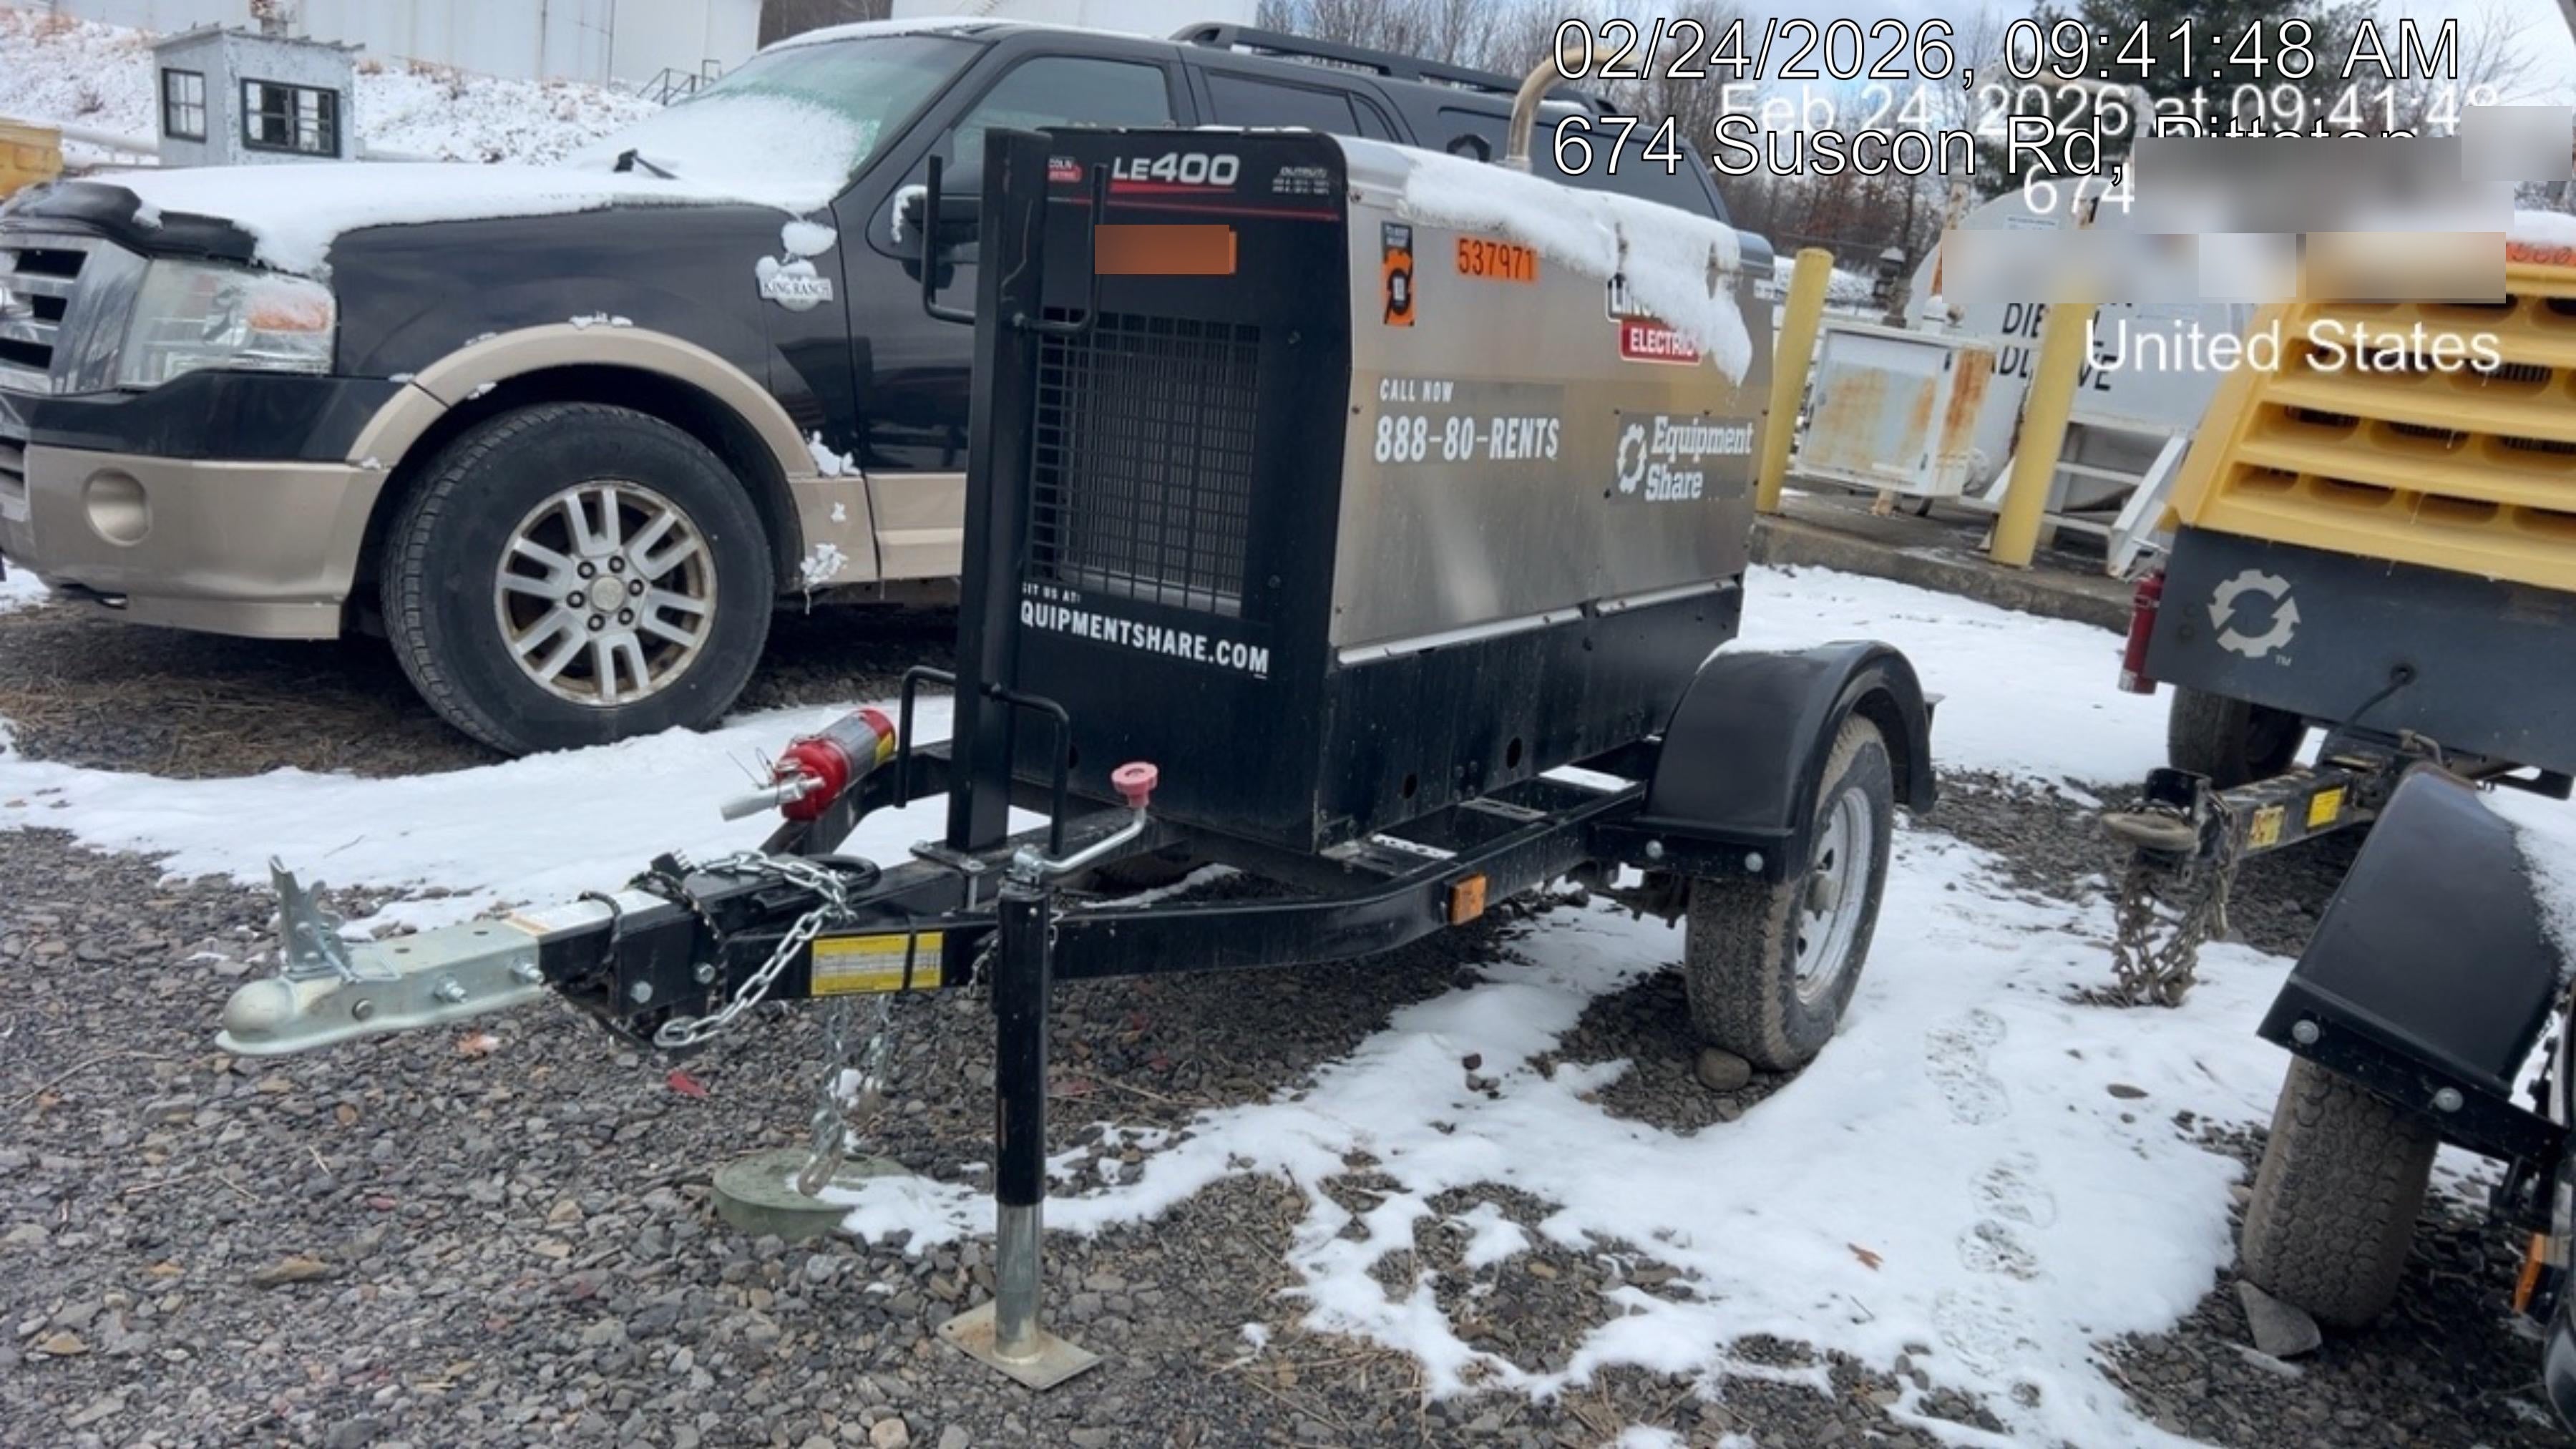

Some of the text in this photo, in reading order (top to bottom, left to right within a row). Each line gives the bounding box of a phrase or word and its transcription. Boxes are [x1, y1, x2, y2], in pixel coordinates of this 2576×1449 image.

[1112, 152, 1240, 185] LE400
[1458, 237, 1536, 280] 537971
[1379, 379, 1454, 402] CALL NOW
[1375, 415, 1559, 463] 888-80-RENTS
[1650, 415, 1755, 462] Equipment
[1644, 462, 1702, 501] Share
[1020, 600, 1269, 675] QUIPMENTSHARE.COM
